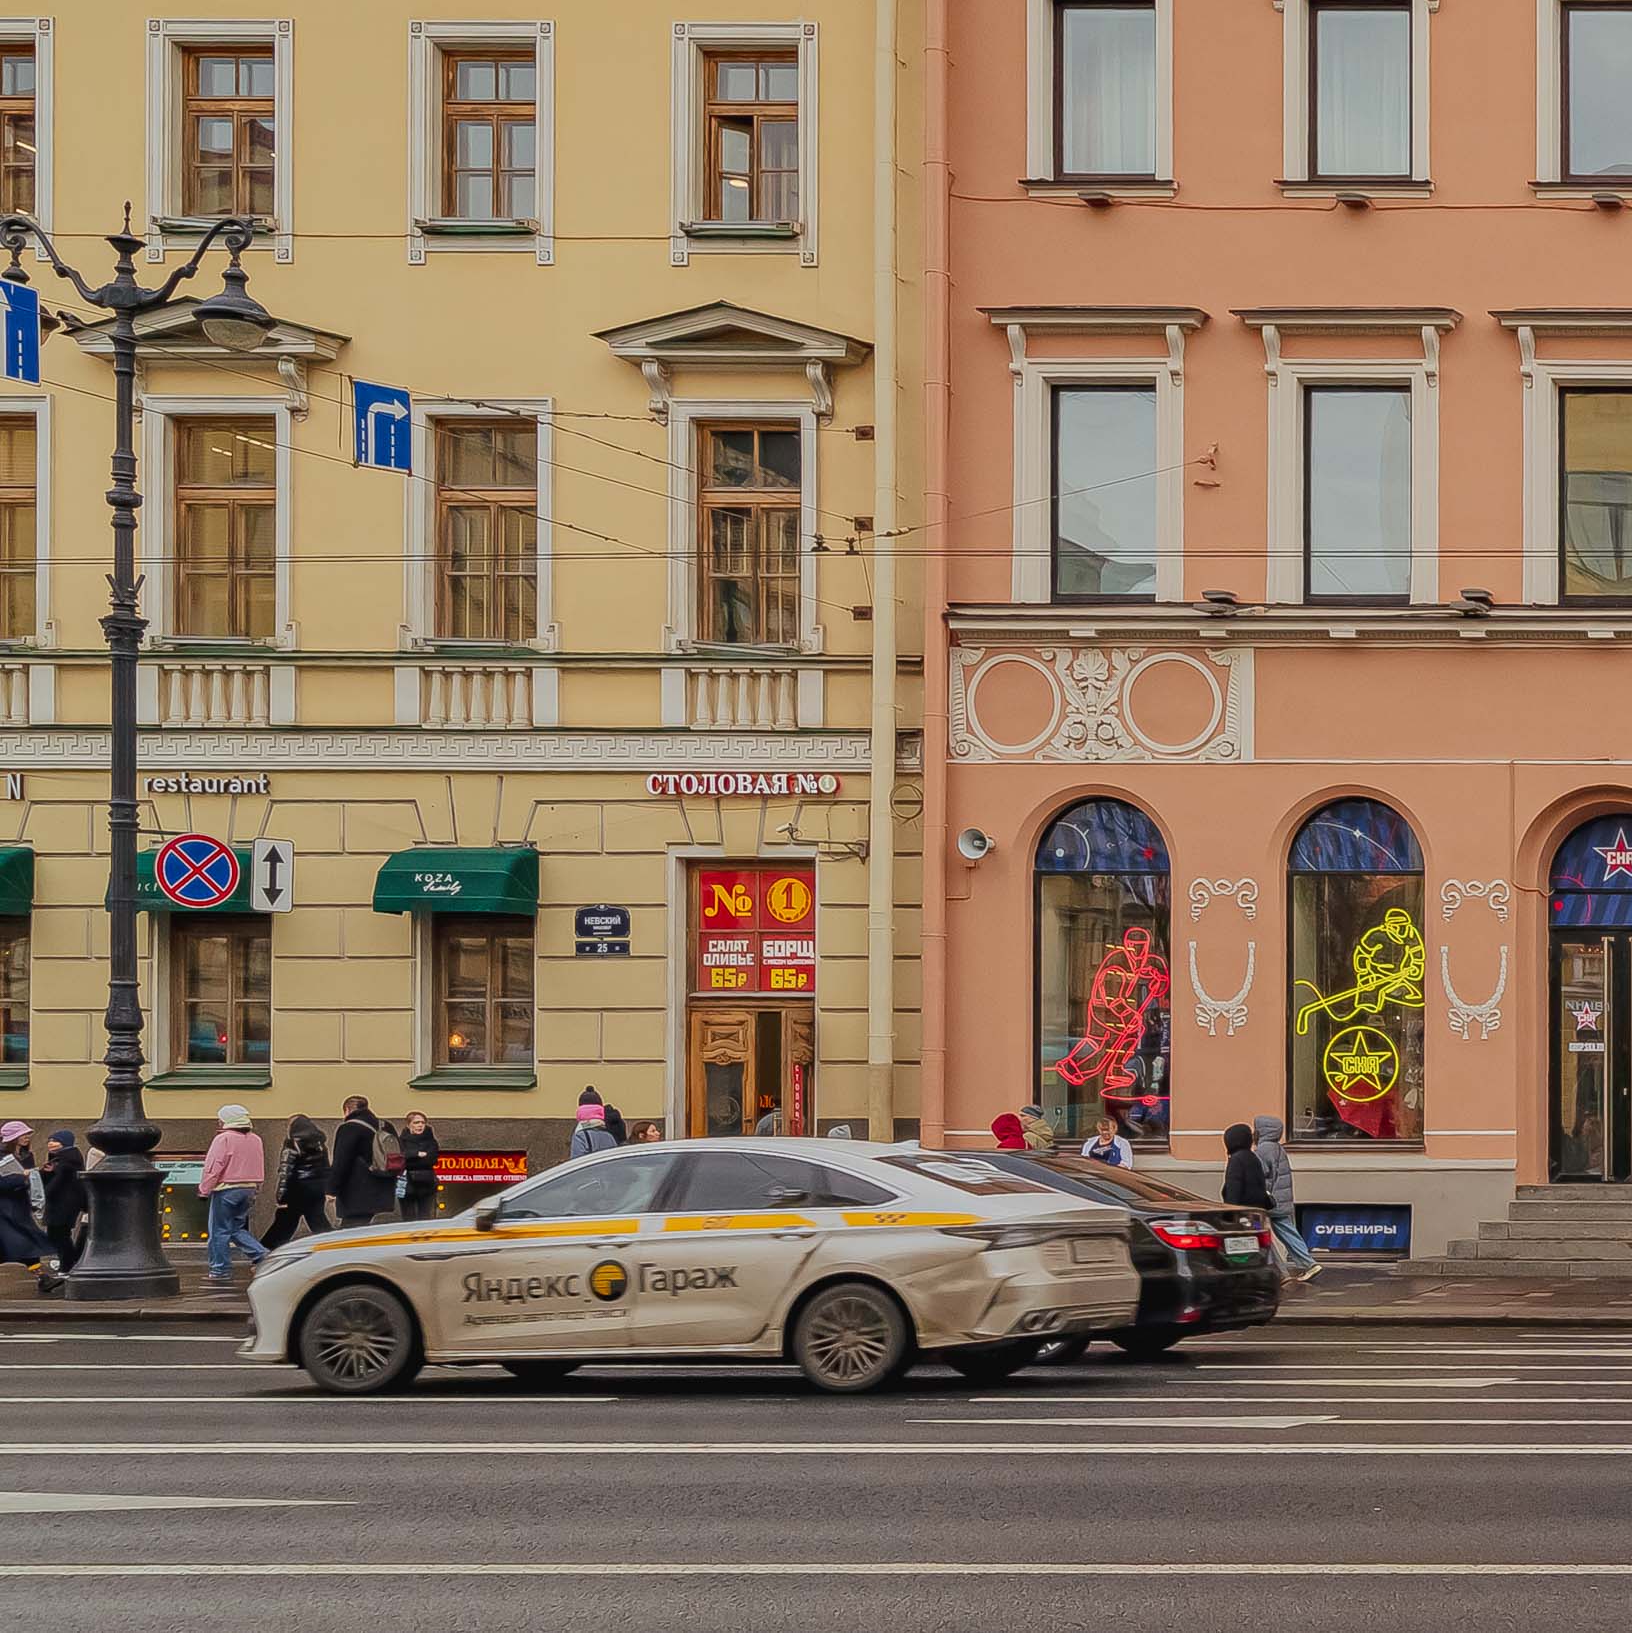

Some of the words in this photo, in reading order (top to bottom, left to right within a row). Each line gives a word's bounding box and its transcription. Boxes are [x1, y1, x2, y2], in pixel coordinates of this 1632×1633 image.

[144, 772, 270, 794] restaurant
[646, 773, 790, 795] СТОЛОВАЯ
[415, 873, 452, 882] KOZA
[584, 915, 621, 925] НЕВСКИЙ
[597, 944, 608, 952] 25
[708, 940, 749, 953] САЛАТ
[762, 940, 815, 959] БОРЩ
[703, 954, 755, 966] ОЛИВЬЕ
[1315, 1225, 1397, 1235] СУВЕНИРЫ
[462, 1272, 580, 1305] Яндекс
[638, 1263, 739, 1296] Гараж
